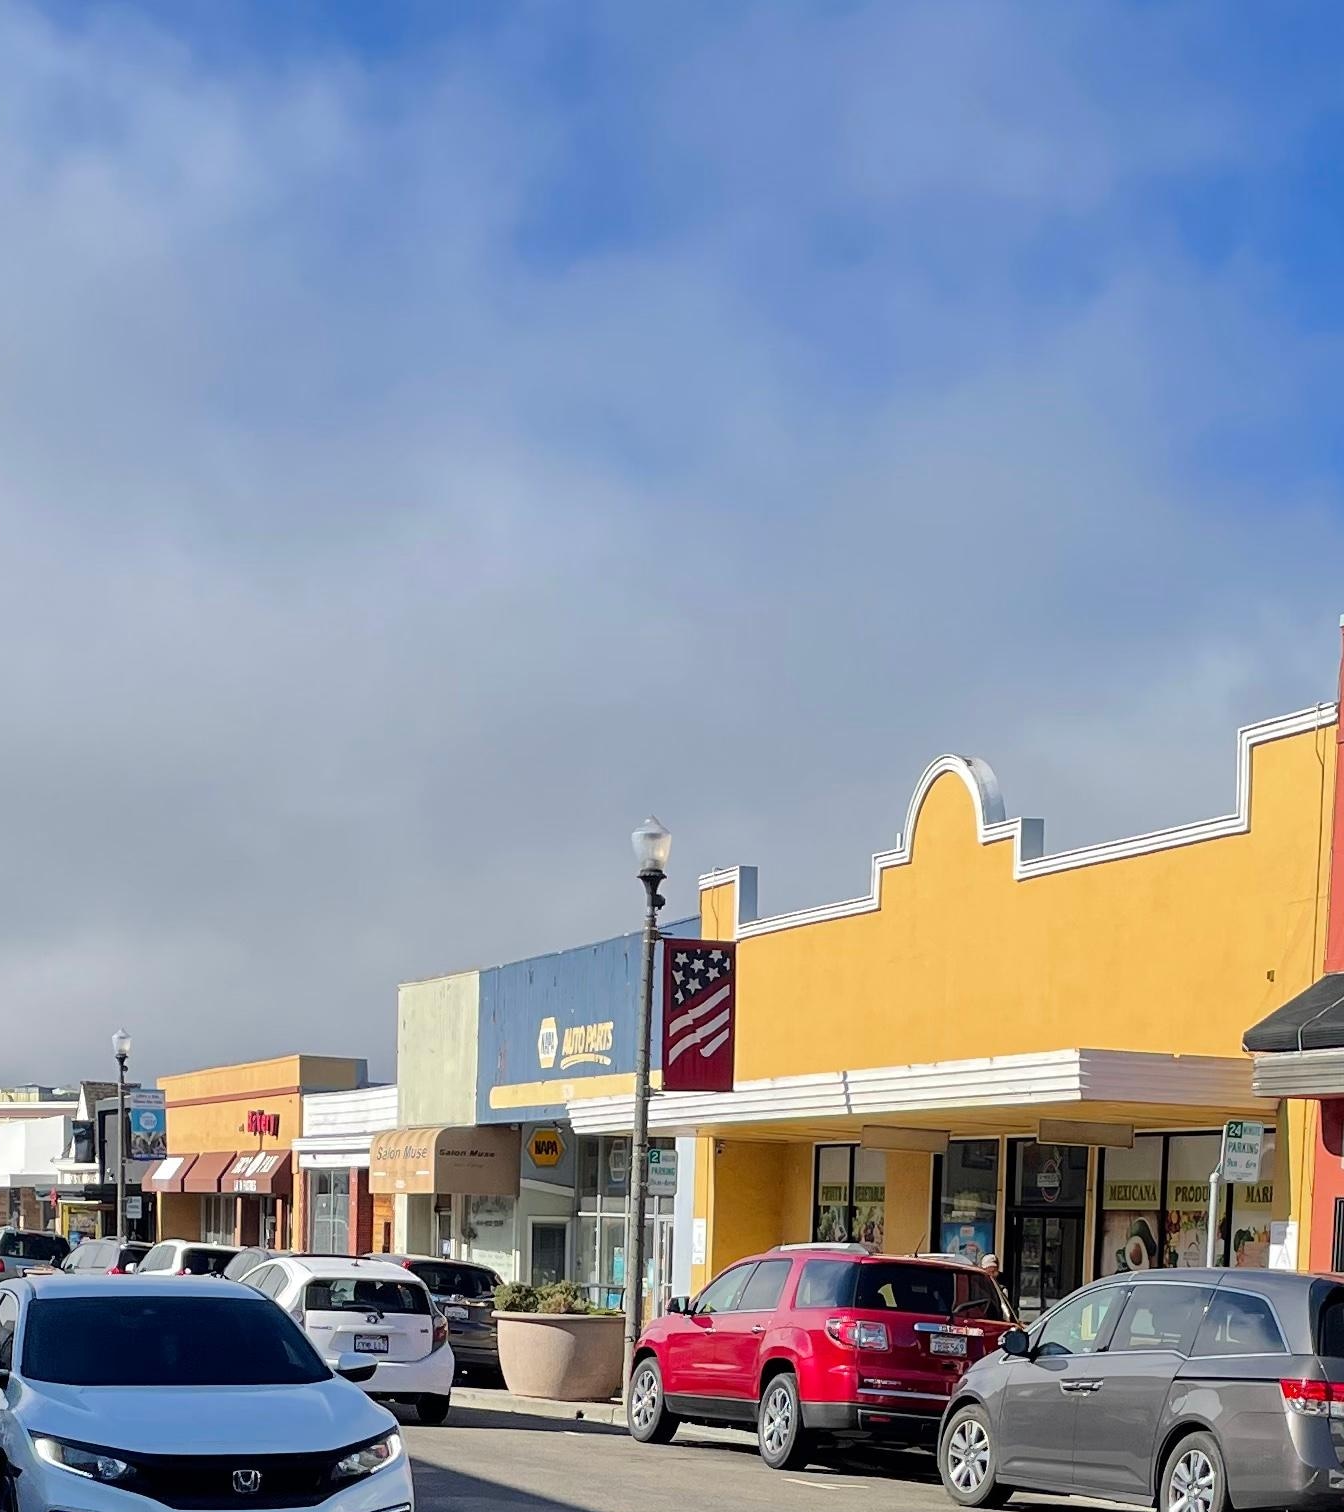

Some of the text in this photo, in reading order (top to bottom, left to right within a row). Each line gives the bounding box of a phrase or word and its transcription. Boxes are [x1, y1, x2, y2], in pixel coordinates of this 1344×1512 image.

[562, 1021, 614, 1056] AUTO PARTS
[1228, 1123, 1242, 1136] 24
[376, 1145, 428, 1161] Salon Muse
[439, 1148, 496, 1158] Salon Muse
[534, 1139, 559, 1156] NAPA
[1227, 1141, 1260, 1154] PARKING
[651, 1150, 659, 1162] 2
[1109, 1184, 1157, 1202] MEXICANA
